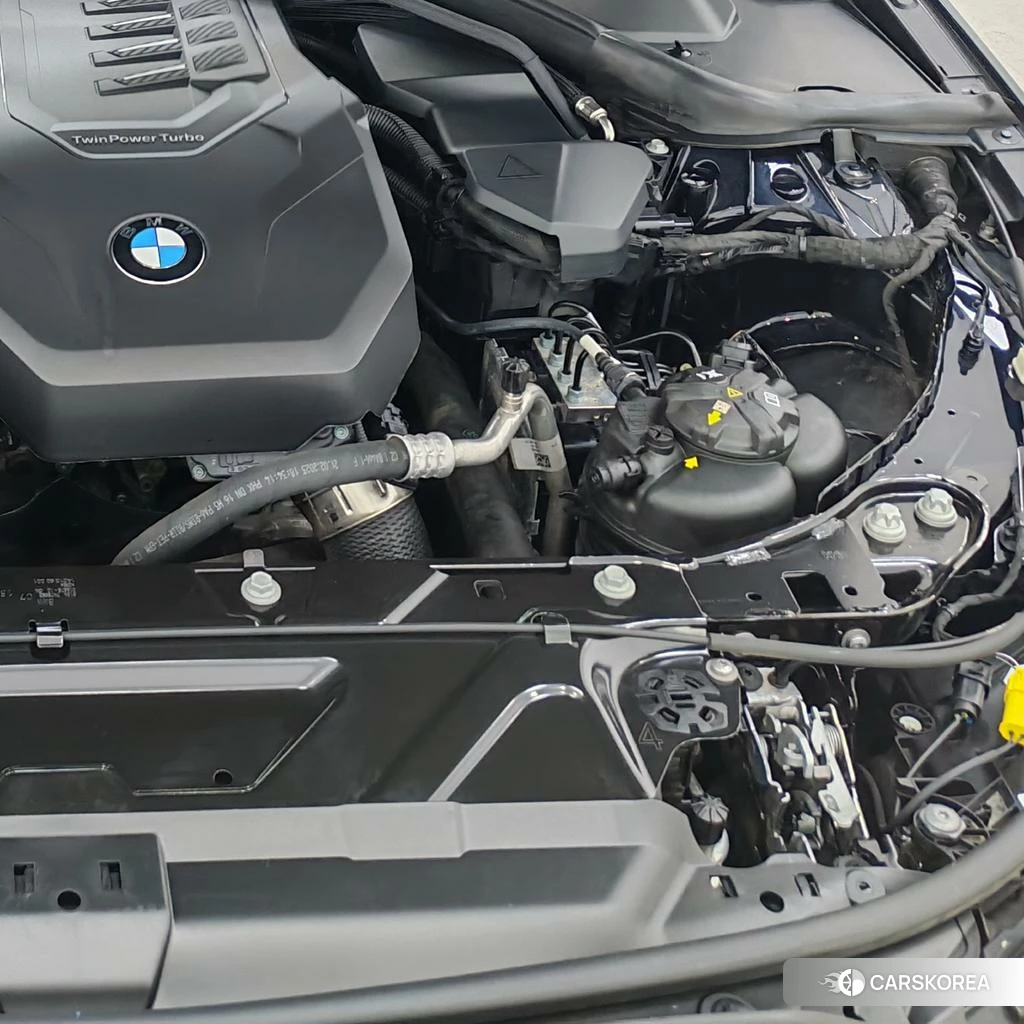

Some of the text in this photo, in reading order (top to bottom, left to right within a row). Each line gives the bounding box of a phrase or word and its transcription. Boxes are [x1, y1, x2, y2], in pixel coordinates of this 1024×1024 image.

[159, 133, 205, 142] Turbo
[120, 216, 193, 239] BMW
[638, 720, 664, 751] 4
